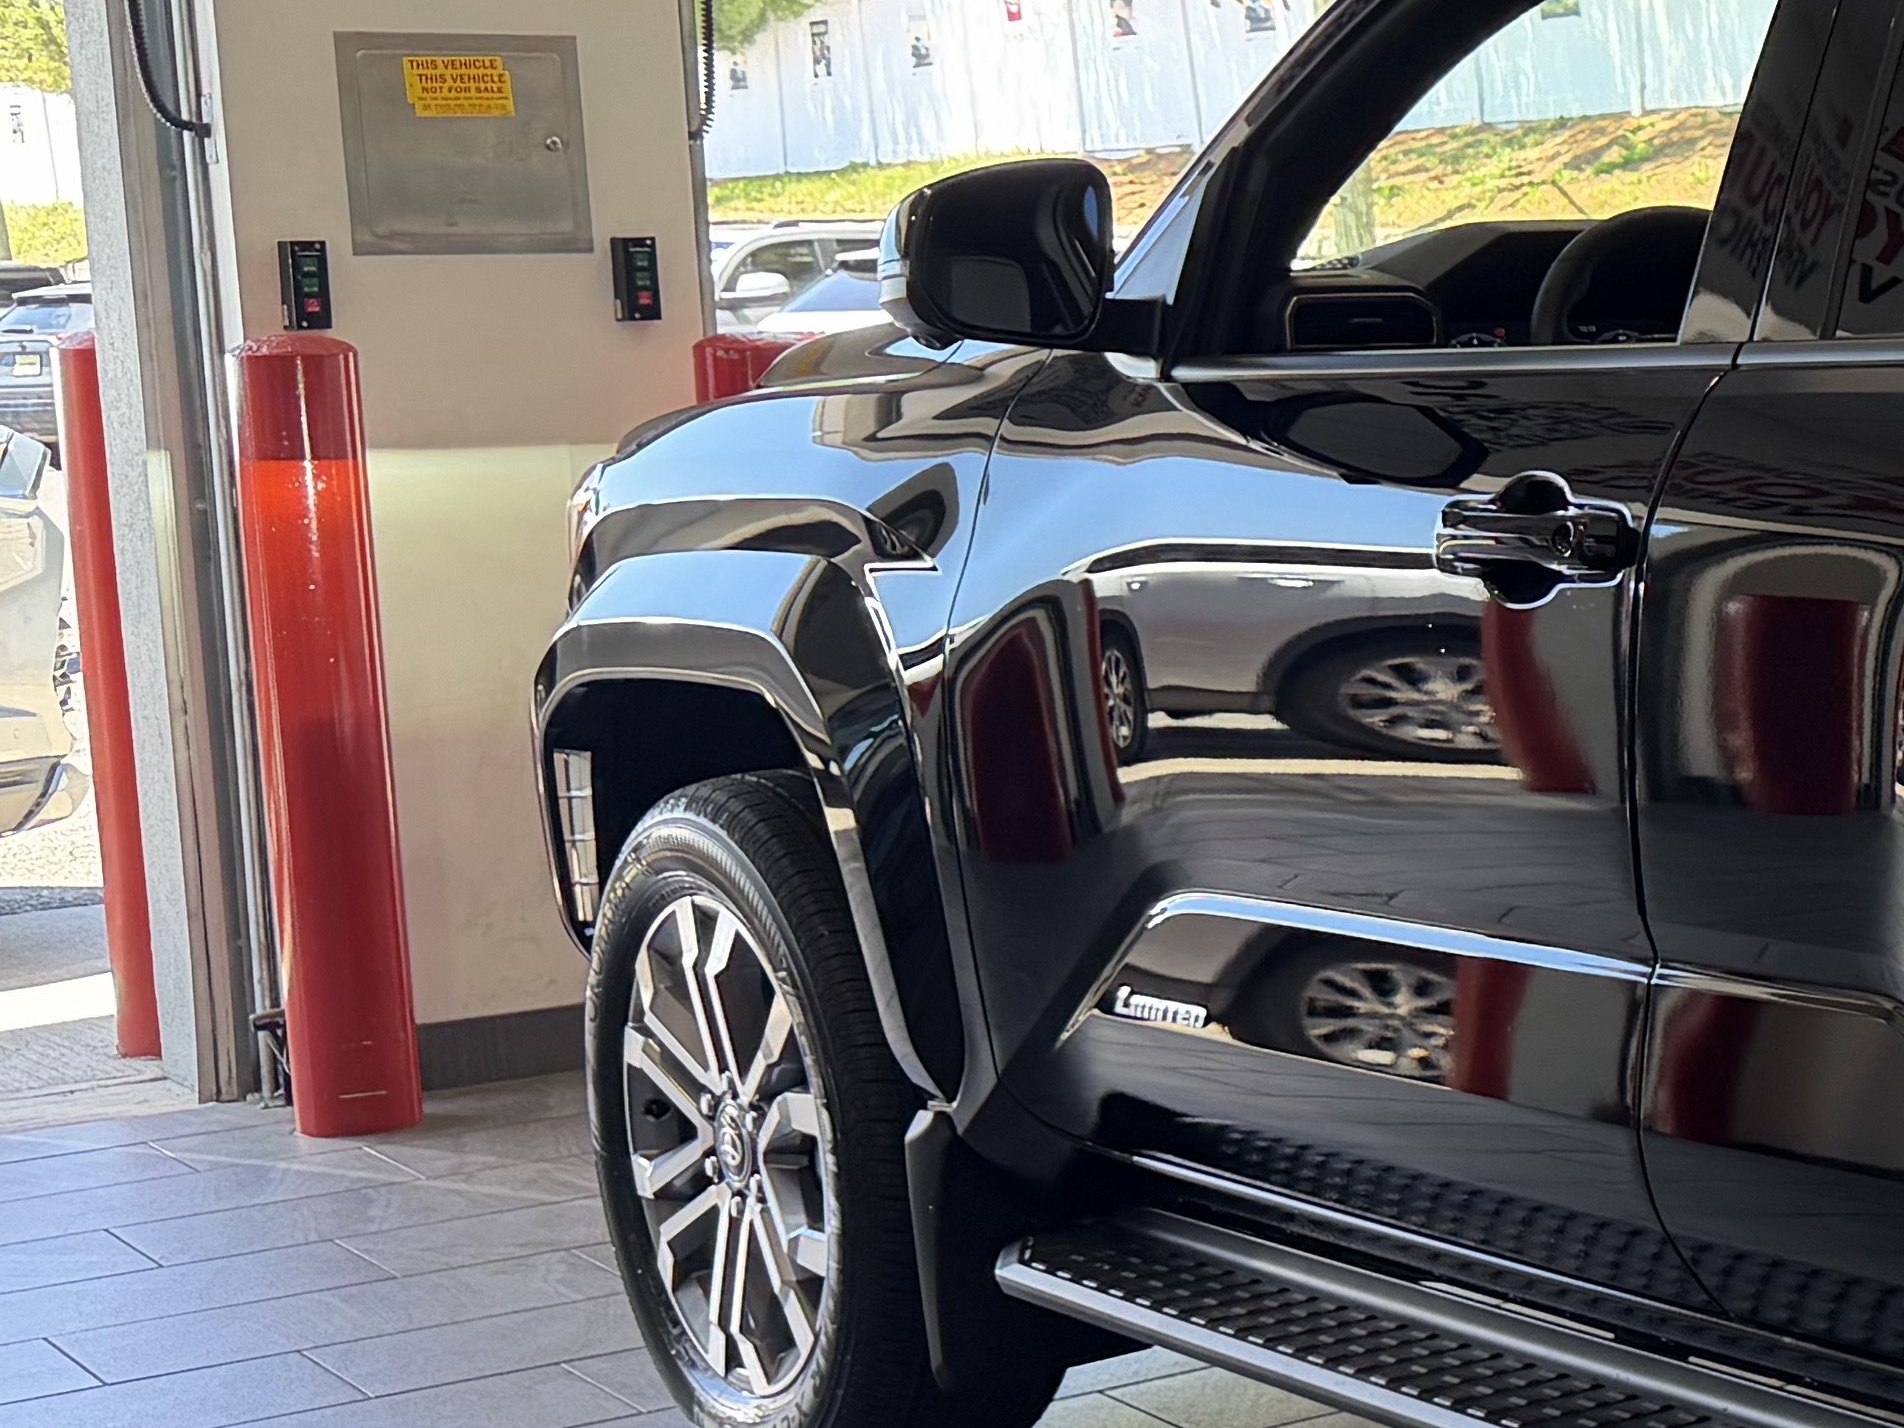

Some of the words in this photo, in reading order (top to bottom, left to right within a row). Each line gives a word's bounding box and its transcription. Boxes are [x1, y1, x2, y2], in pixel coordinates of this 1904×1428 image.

[408, 59, 438, 70] THIS
[441, 59, 497, 70] VEHICLE
[417, 73, 447, 84] THIS
[450, 74, 506, 84] VEHICLE
[422, 85, 444, 94] NOT
[448, 86, 471, 94] FOR
[475, 86, 504, 94] SALE
